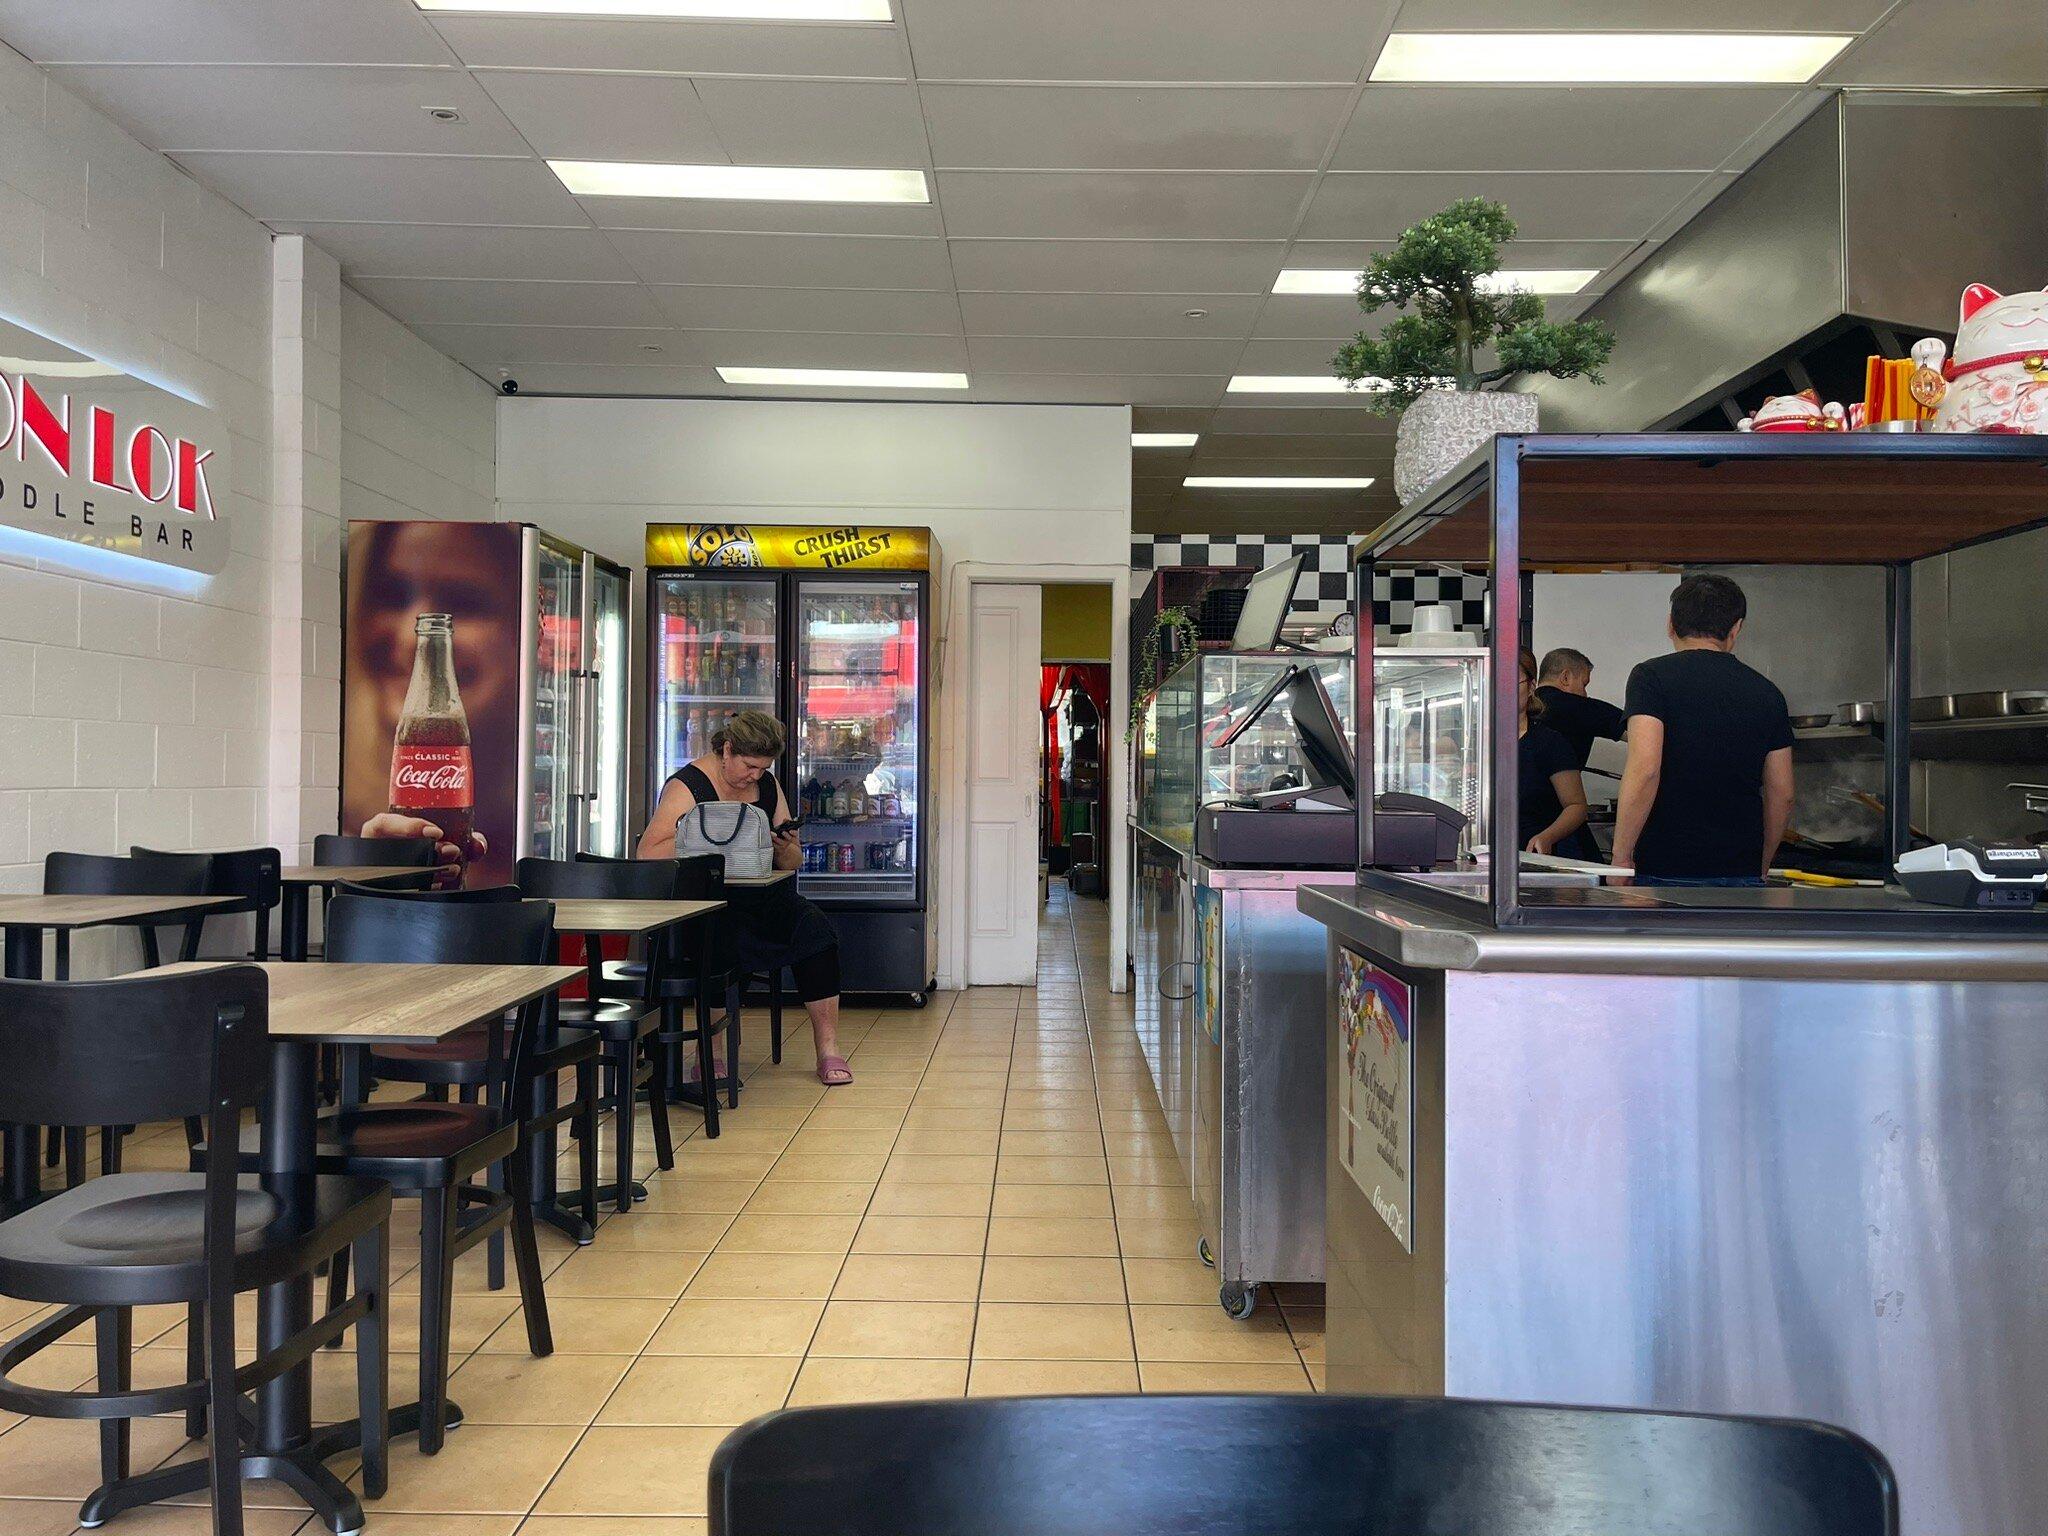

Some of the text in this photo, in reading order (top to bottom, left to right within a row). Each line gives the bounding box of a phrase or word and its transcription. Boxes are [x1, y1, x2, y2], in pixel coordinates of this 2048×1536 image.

[89, 404, 216, 521] LOK
[131, 514, 193, 551] BAR
[794, 527, 860, 556] CRUSH
[820, 533, 891, 568] THIRST
[414, 753, 450, 761] CLASSIC
[396, 765, 468, 789] Coca-Cola
[1369, 1062, 1398, 1113] Original
